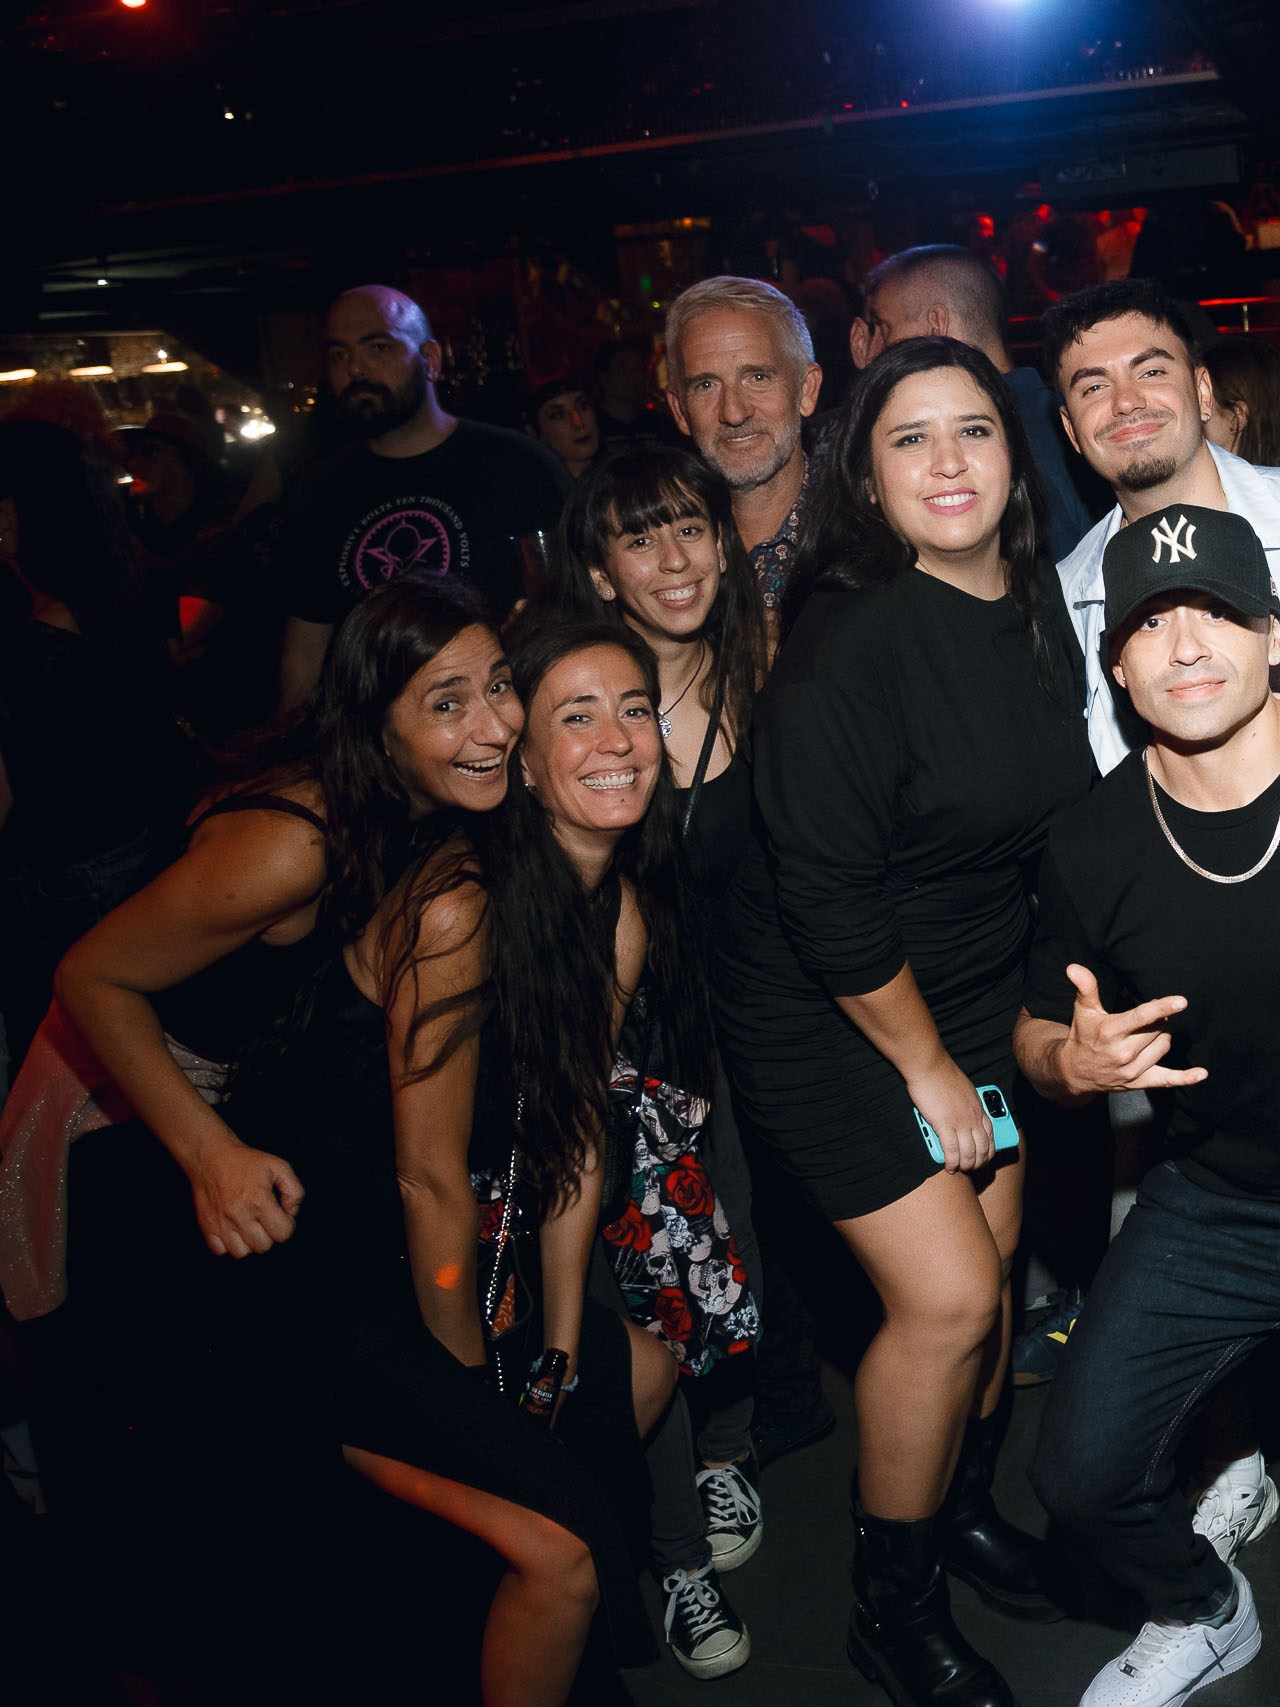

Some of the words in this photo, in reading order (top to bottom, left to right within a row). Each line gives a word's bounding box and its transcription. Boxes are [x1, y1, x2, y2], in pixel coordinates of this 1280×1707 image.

[396, 496, 417, 506] TEN
[420, 495, 464, 530] THOUSAND
[459, 531, 471, 568] VOLTS
[1151, 514, 1198, 564] NY
